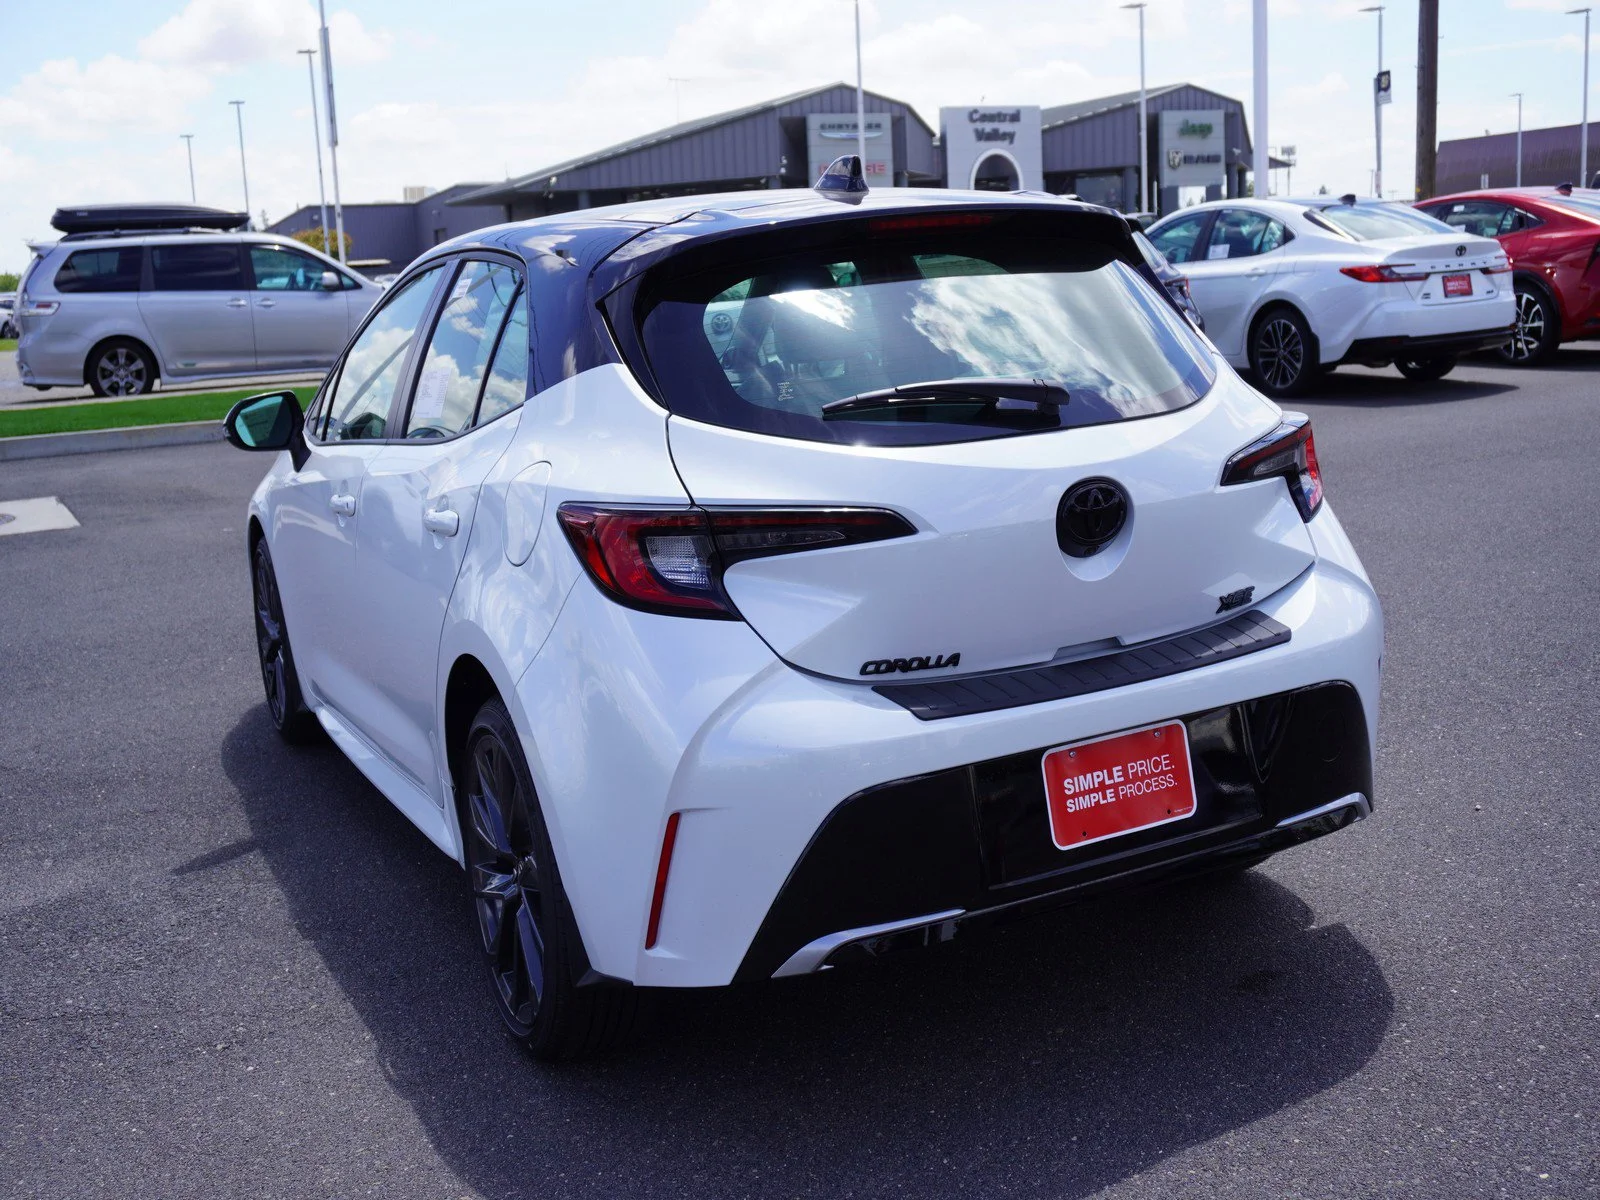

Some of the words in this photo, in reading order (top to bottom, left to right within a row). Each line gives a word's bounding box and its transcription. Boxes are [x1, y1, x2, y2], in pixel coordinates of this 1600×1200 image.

[968, 109, 1021, 123] Central
[974, 127, 1016, 145] Valley
[1178, 119, 1213, 139] Jeep
[1215, 586, 1255, 614] XSE
[859, 652, 961, 676] COROLLA
[1063, 766, 1124, 795] SIMPLE
[1127, 754, 1175, 779] PRICE.
[1066, 788, 1116, 813] SIMPLE
[1118, 773, 1178, 799] PROCESS.
